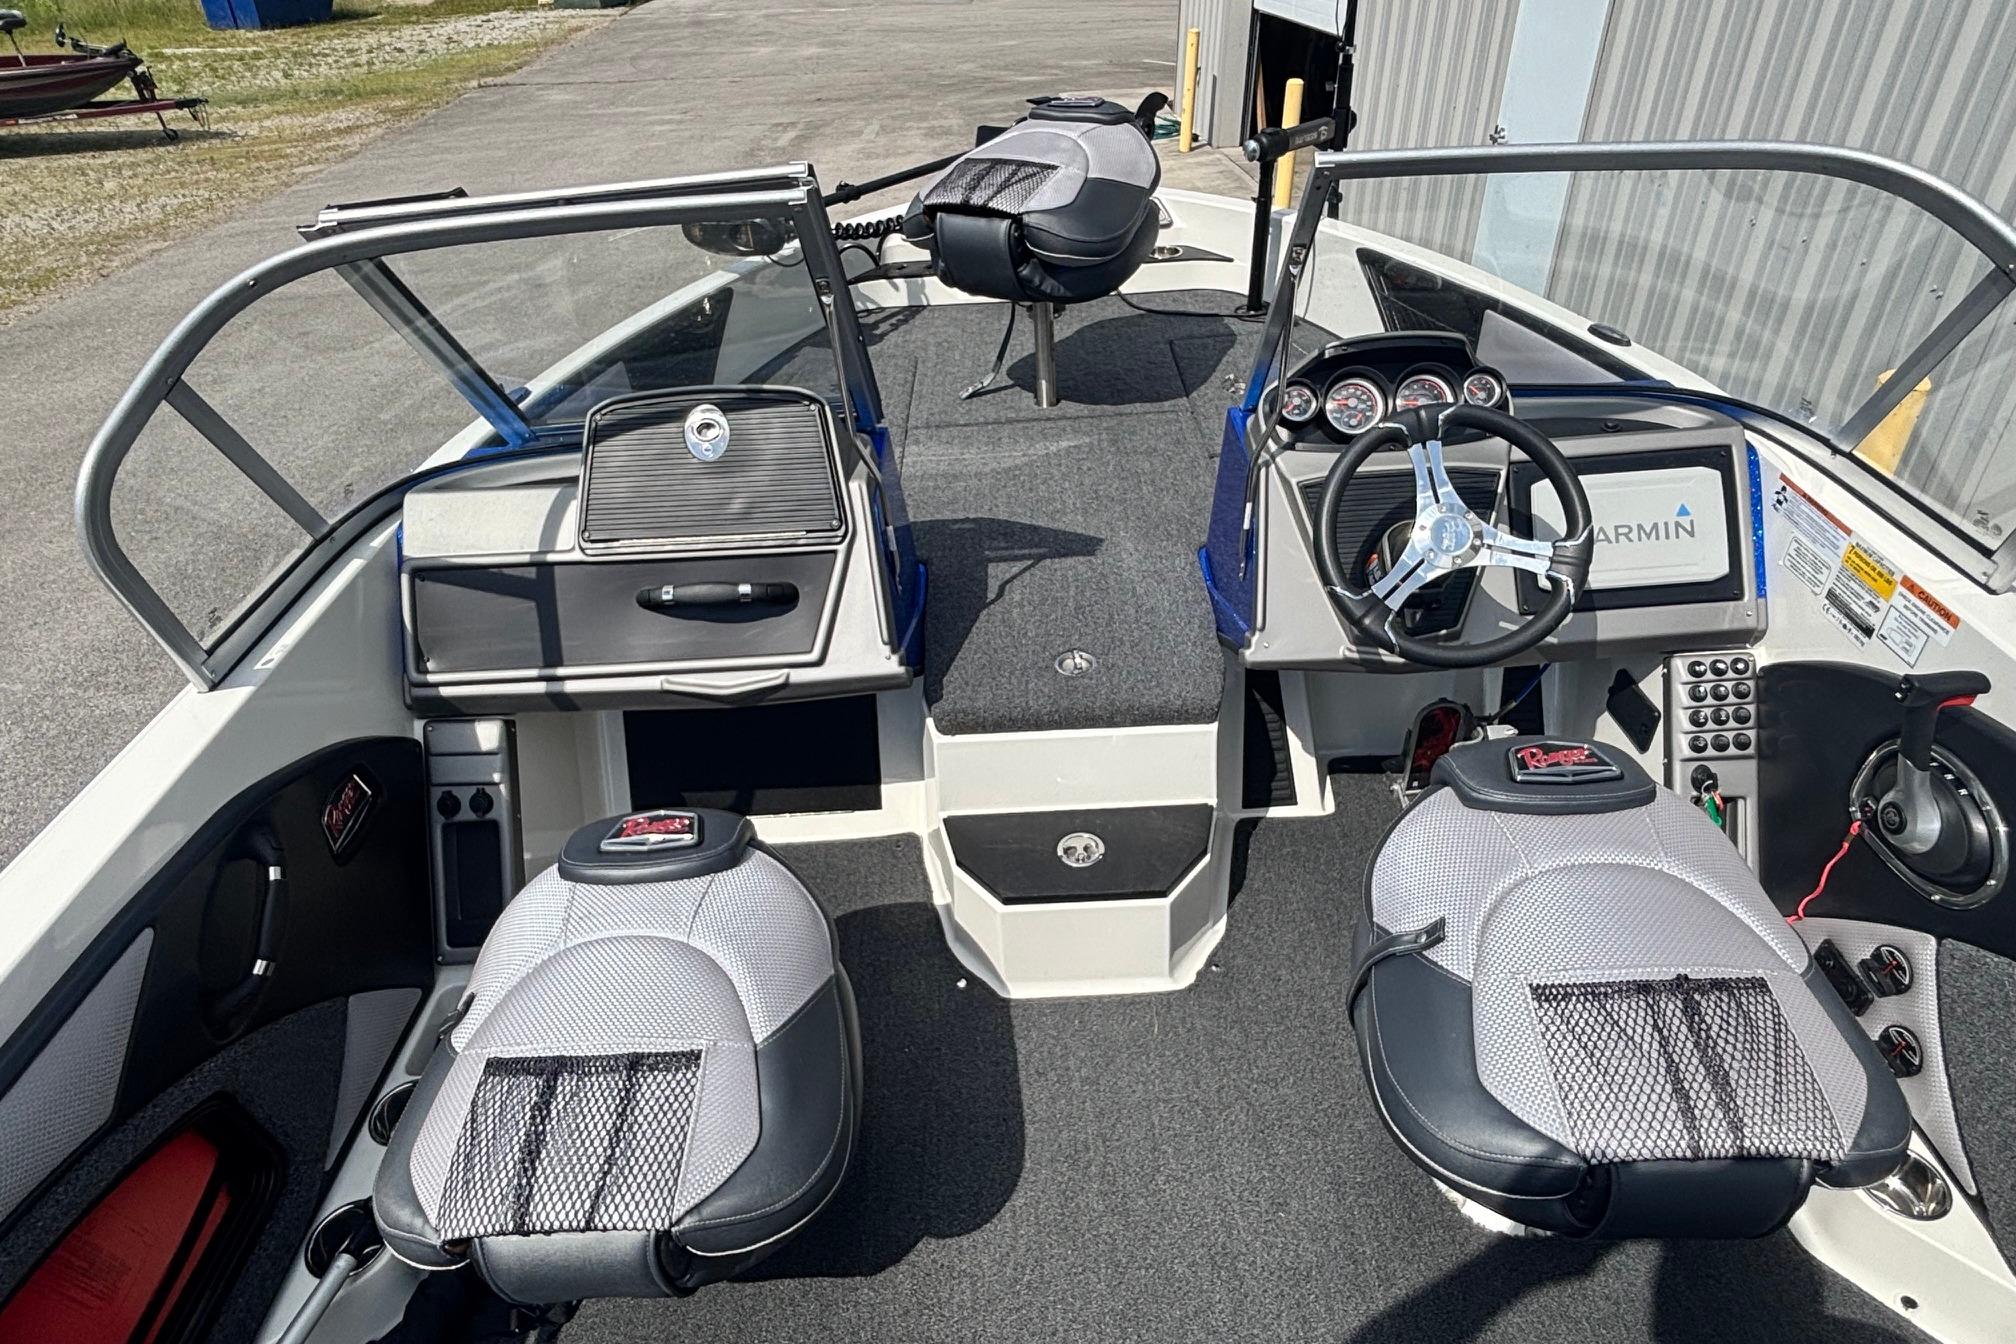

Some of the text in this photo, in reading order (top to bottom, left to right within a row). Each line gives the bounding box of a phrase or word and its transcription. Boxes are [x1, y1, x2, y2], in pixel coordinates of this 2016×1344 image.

[1594, 518, 1696, 545] ARMIN
[1917, 590, 1953, 622] CAUTION
[1517, 747, 1591, 771] Ranger
